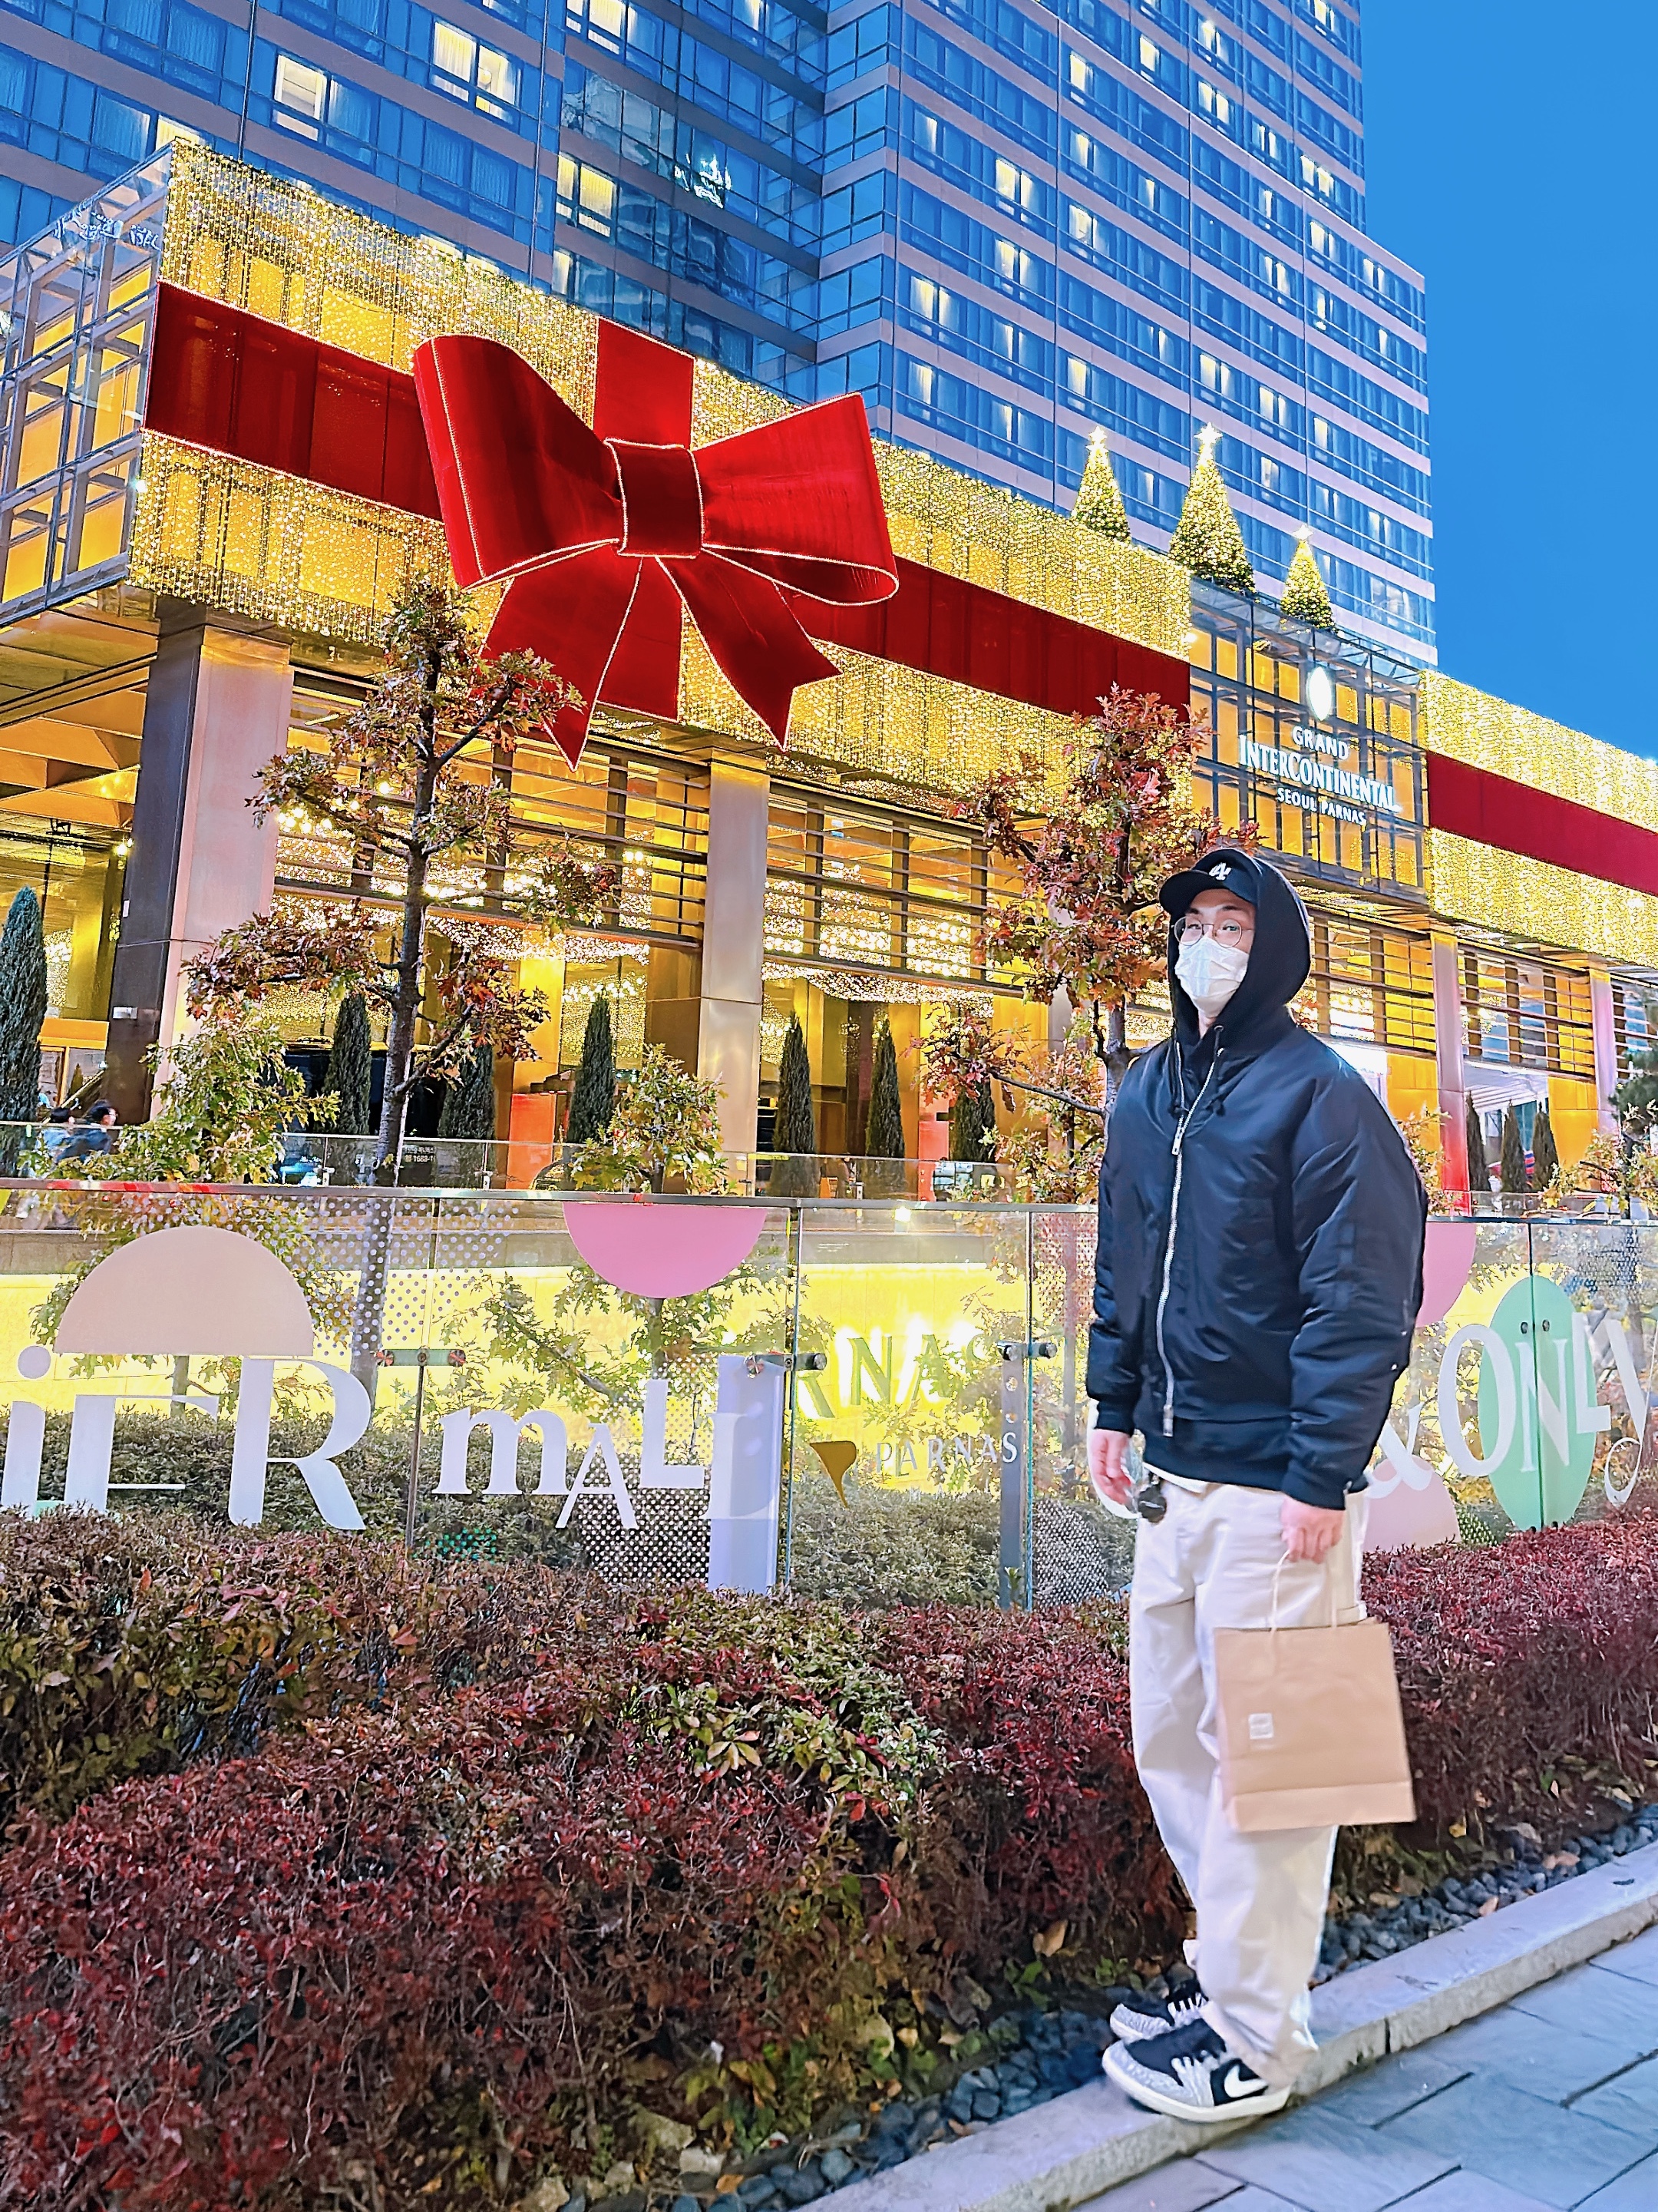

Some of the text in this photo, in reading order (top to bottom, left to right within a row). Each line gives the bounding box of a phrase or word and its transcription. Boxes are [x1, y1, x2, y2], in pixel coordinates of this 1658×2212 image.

[1292, 726, 1349, 760] GRAND
[1238, 735, 1402, 813] INTERCONTINENTAL
[1277, 787, 1367, 826] SEOUL PARNAS
[876, 1431, 1018, 1473] PARNAS
